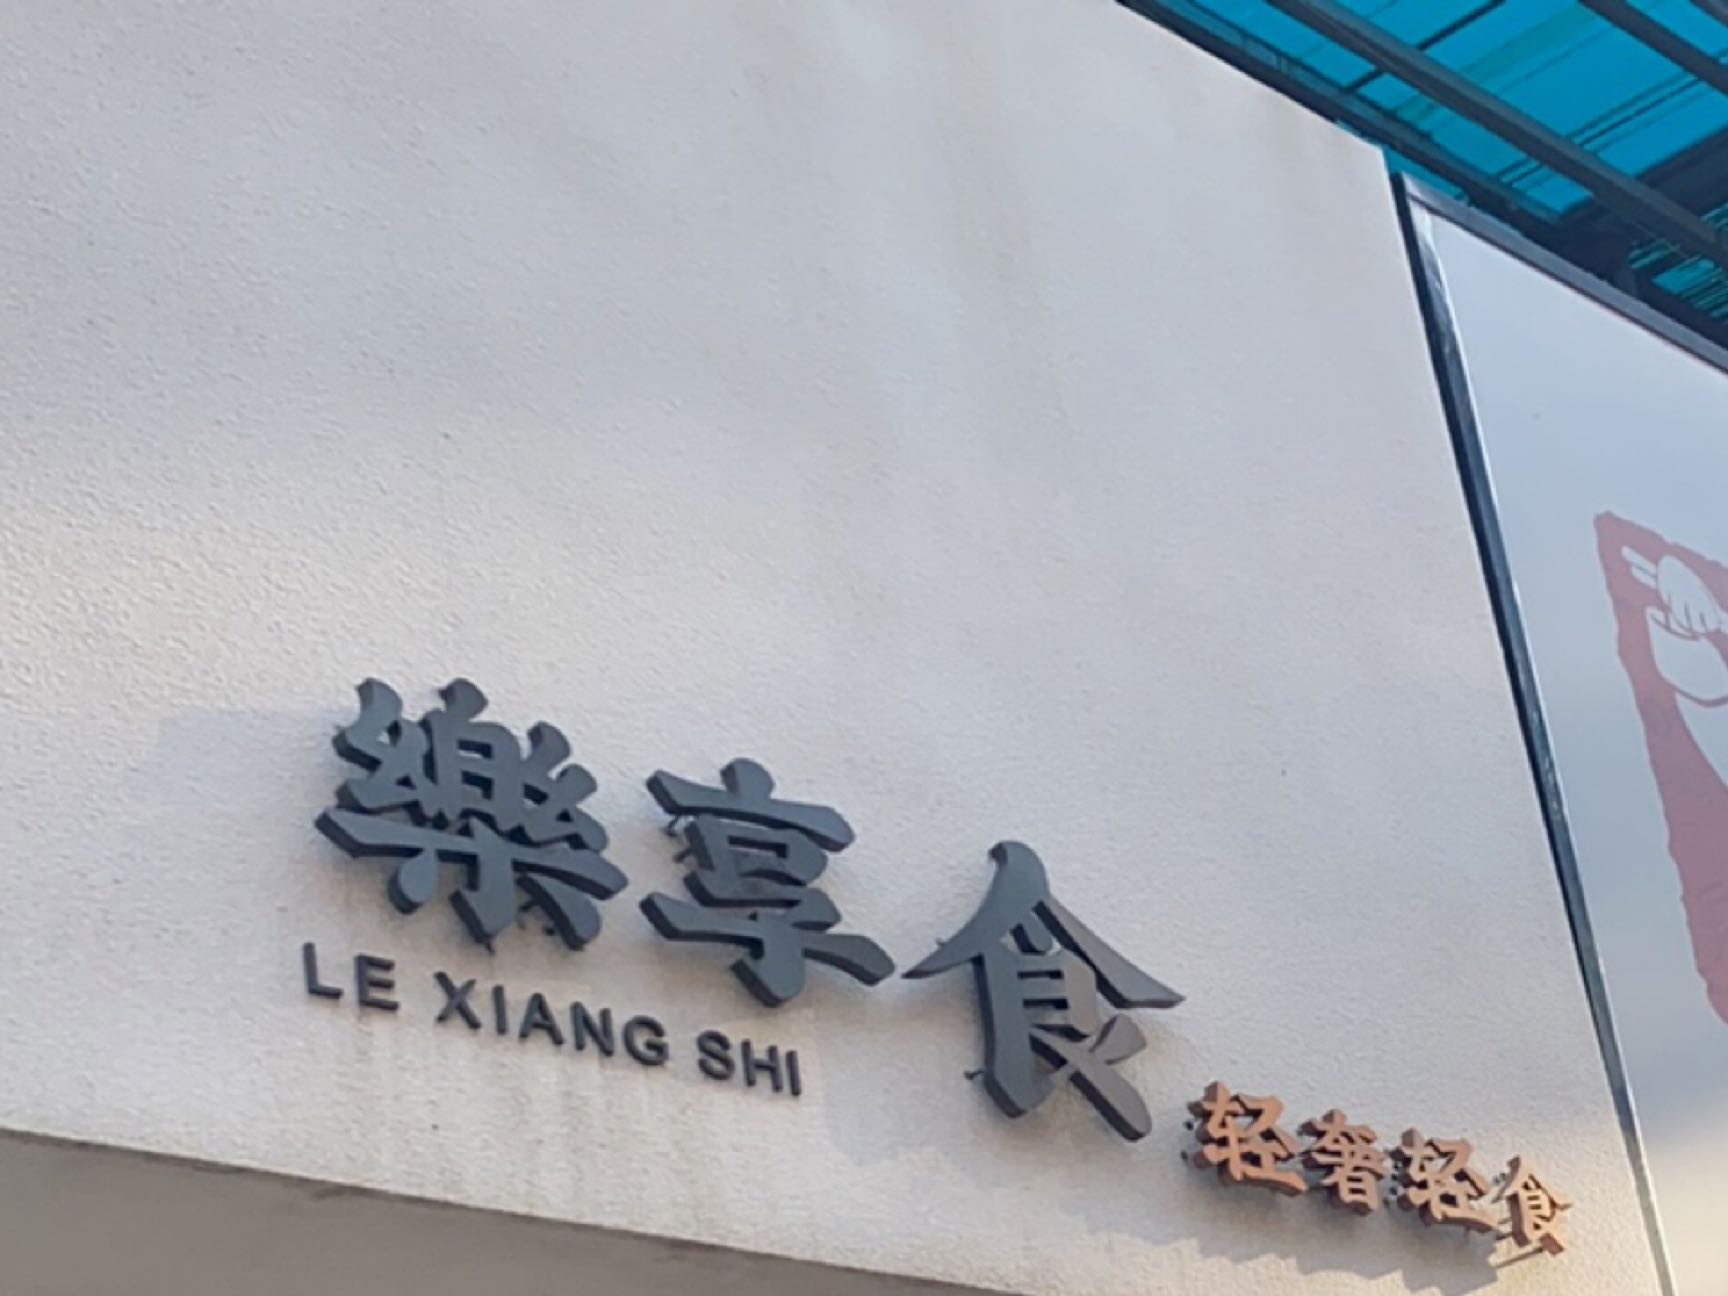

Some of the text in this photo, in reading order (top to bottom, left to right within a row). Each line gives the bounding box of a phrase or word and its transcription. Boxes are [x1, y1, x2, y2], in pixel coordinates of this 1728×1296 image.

[302, 942, 803, 1096] LE XIANG SHI
[1187, 1080, 1572, 1256] 轻奢轻食
